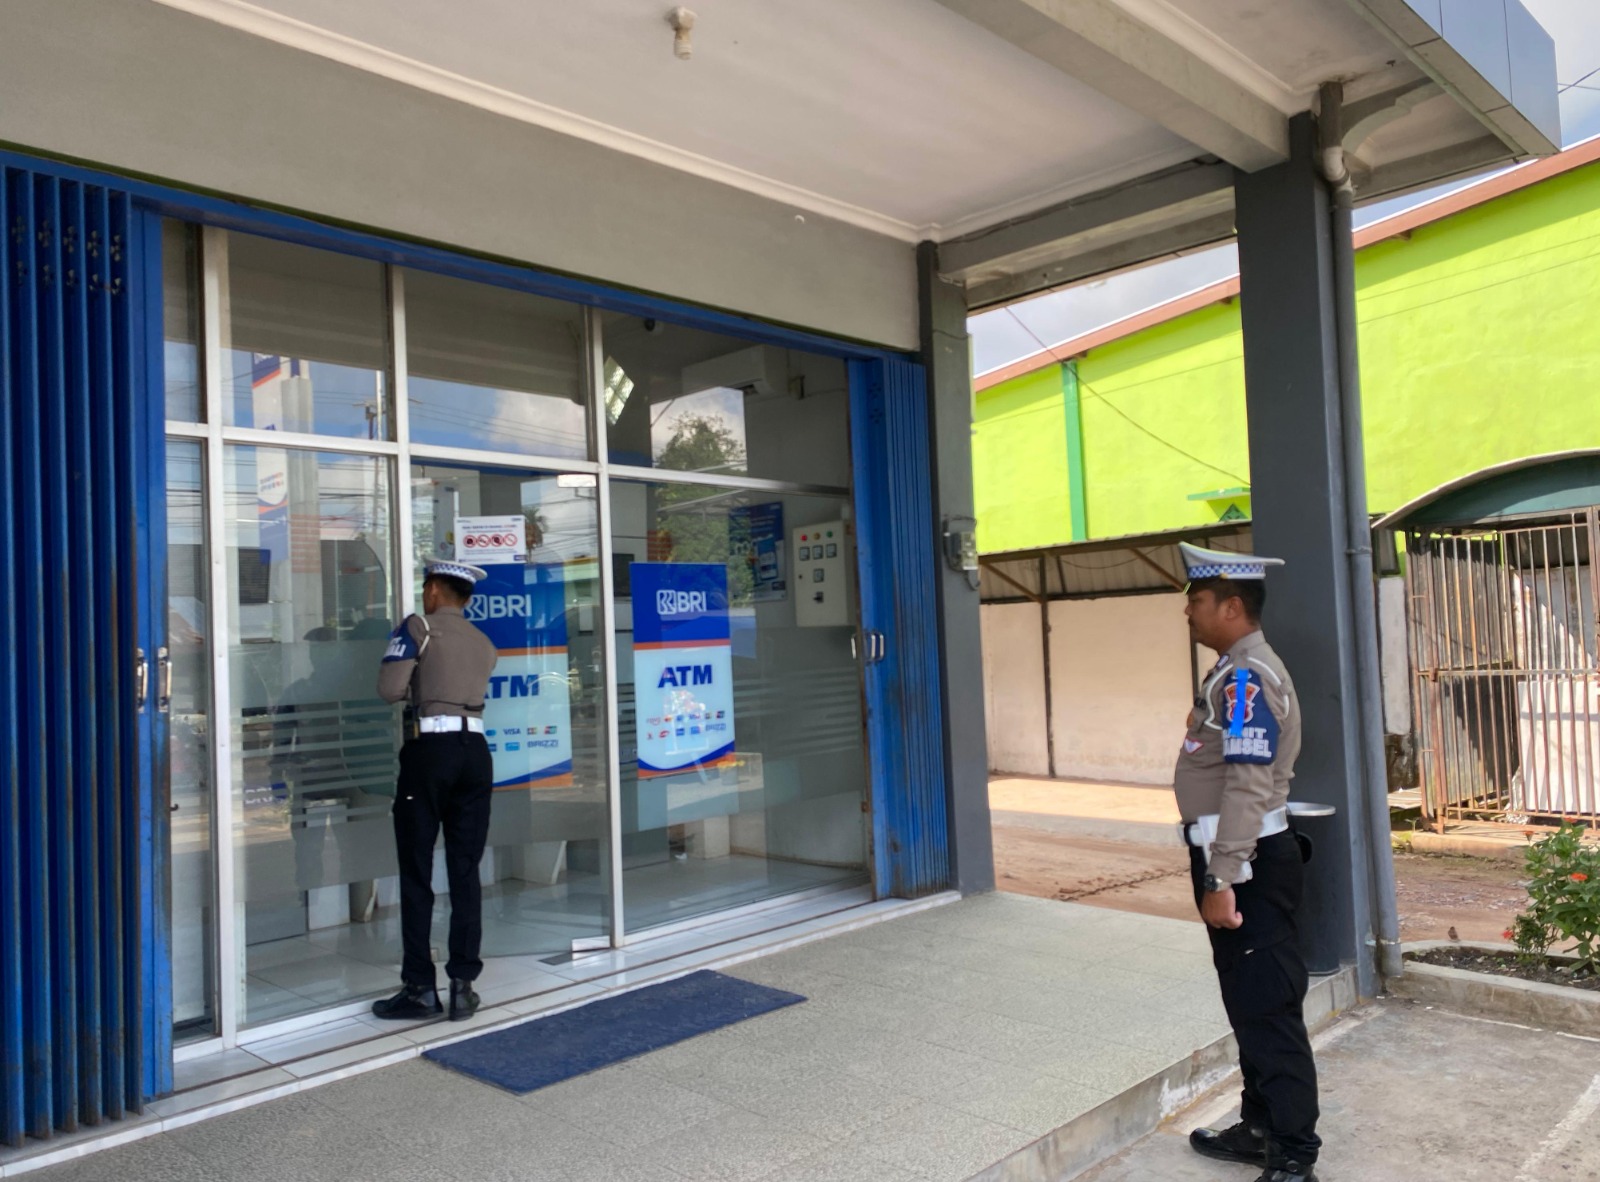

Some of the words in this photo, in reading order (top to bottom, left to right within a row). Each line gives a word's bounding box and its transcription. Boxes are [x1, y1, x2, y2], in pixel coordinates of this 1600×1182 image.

[489, 594, 532, 618] BRI
[677, 591, 707, 612] BRI
[484, 675, 539, 699] TM
[658, 664, 712, 688] ATM
